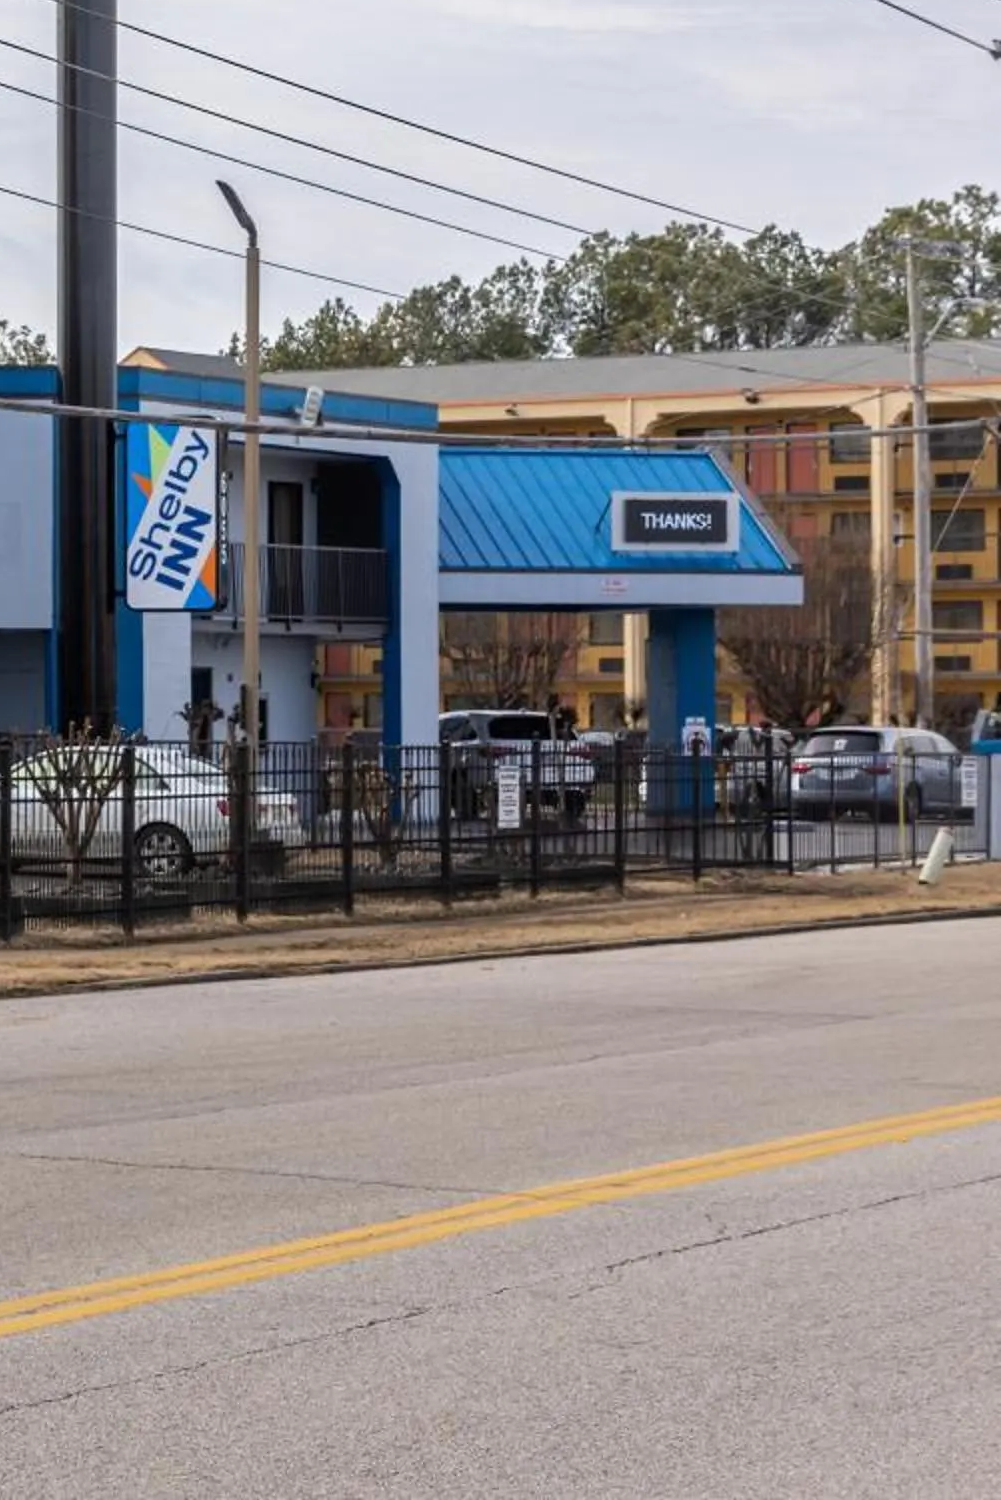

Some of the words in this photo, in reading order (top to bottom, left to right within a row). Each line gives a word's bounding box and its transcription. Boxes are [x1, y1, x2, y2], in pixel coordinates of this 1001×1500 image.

[129, 430, 209, 581] Shelby
[155, 505, 212, 591] INN
[640, 513, 712, 531] THANKS!
